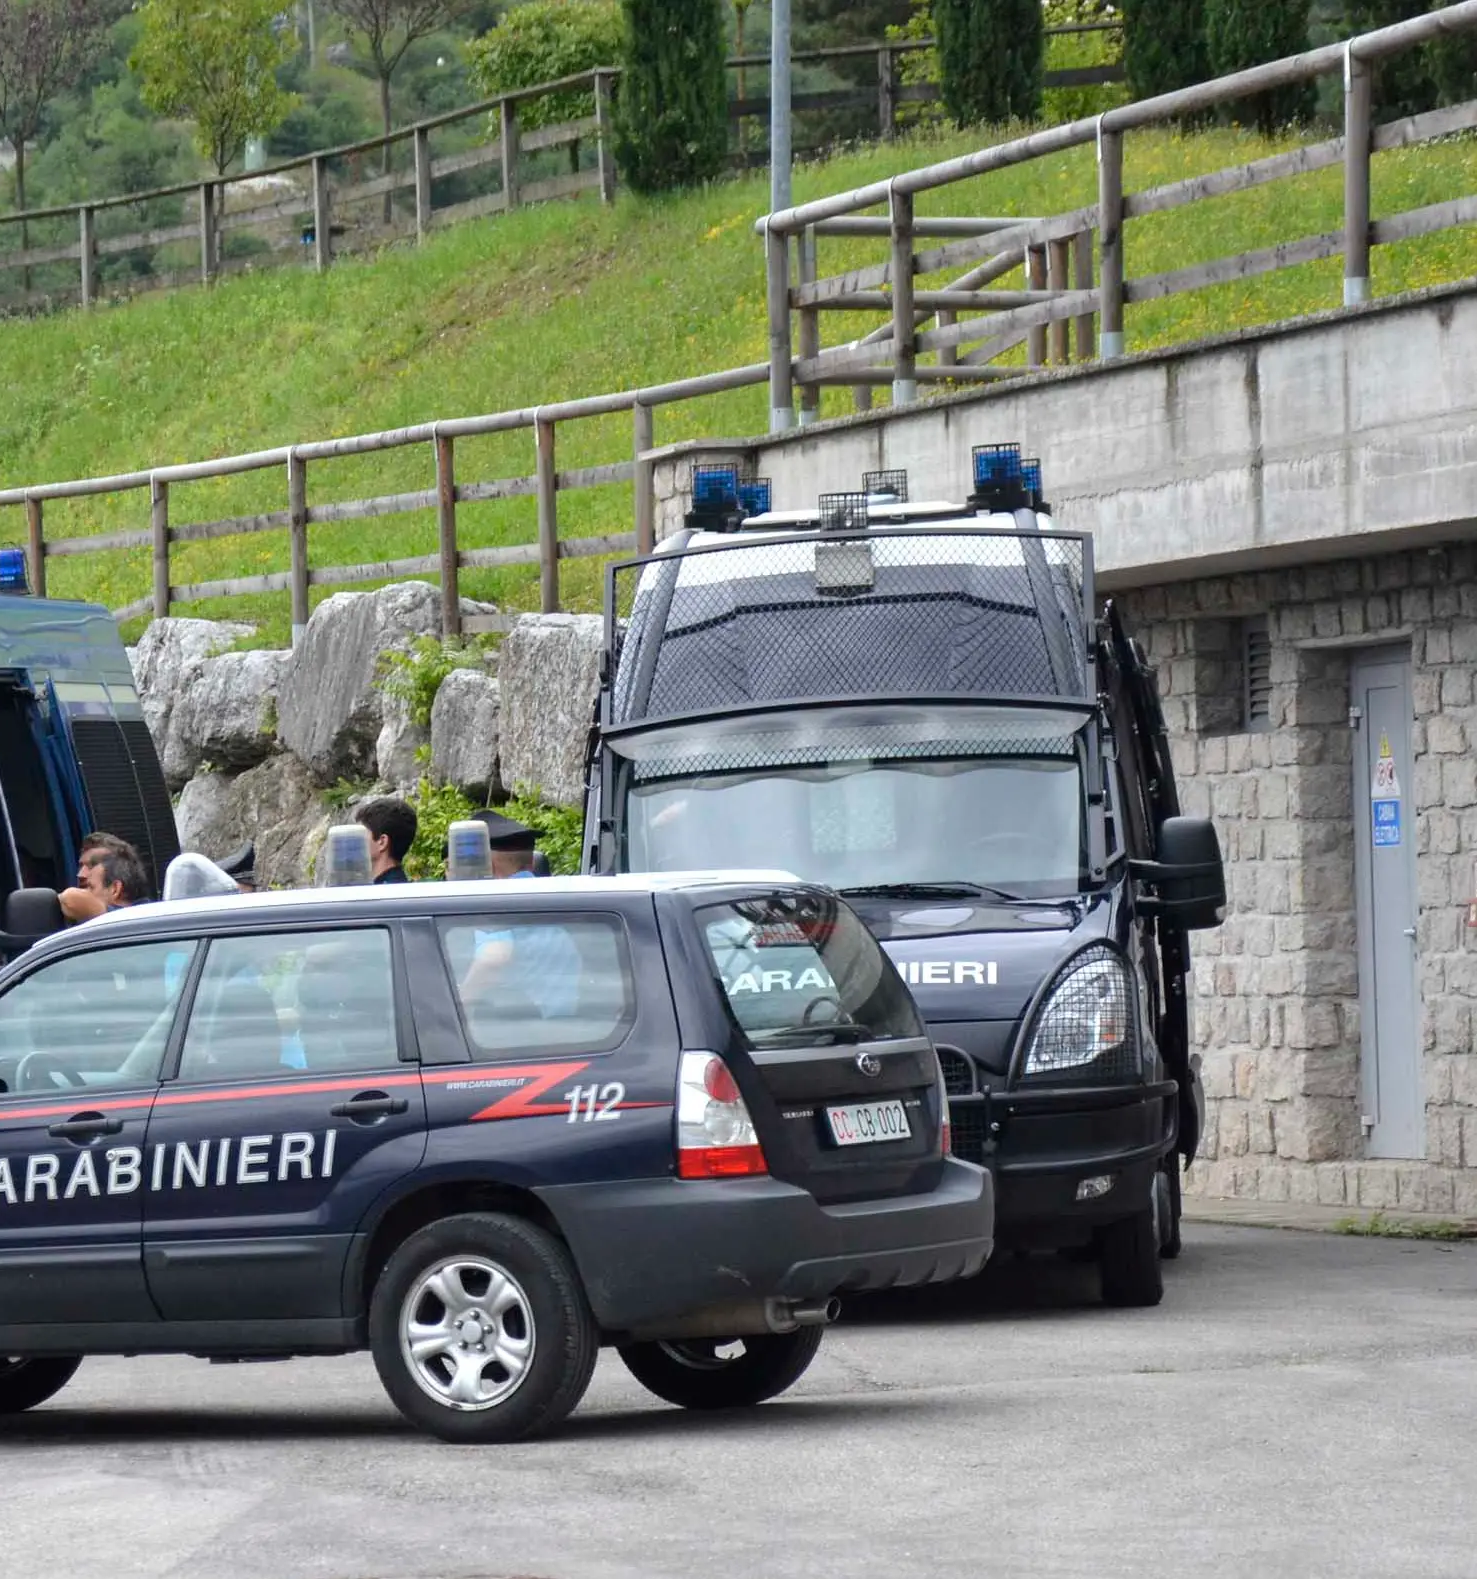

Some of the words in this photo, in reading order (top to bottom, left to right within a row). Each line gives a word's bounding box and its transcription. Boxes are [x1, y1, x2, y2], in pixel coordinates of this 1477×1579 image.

[564, 1081, 626, 1124] 112
[856, 1107, 876, 1137] CB
[877, 1105, 907, 1135] 002
